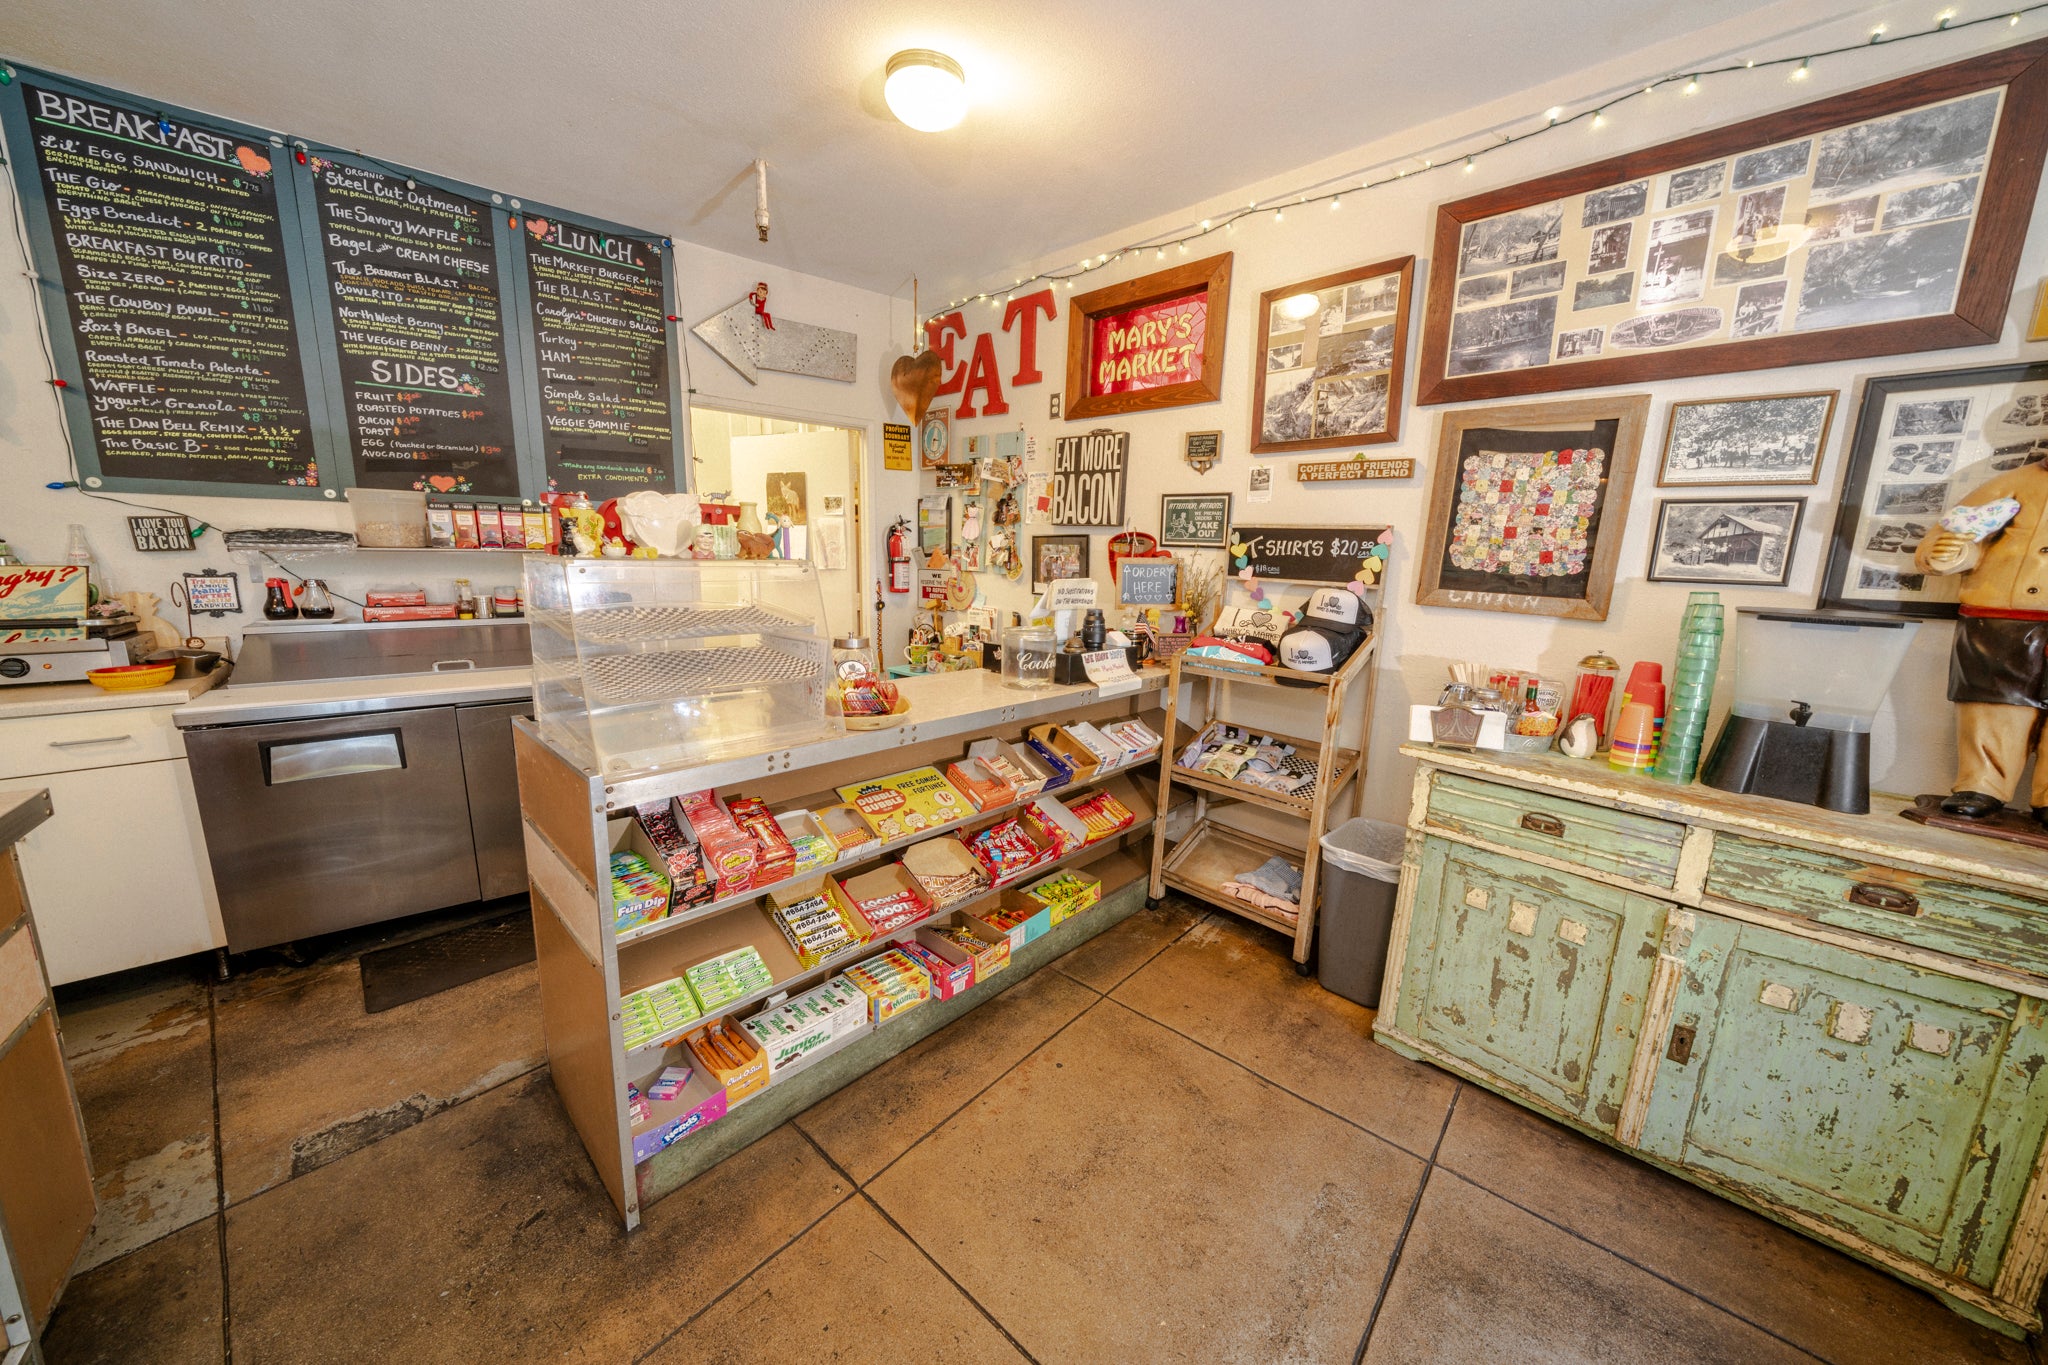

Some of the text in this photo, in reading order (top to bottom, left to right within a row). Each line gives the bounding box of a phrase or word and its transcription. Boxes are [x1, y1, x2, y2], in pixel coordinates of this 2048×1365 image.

[37, 90, 233, 160] BREAKFAST
[88, 145, 127, 163] EGG
[133, 155, 218, 184] SANDWICH
[345, 166, 385, 180] ORGANIC
[44, 167, 81, 184] THE
[325, 171, 471, 217] Steel Cut Oatmeal
[57, 197, 100, 220] Eggs
[103, 205, 182, 229] Benedict
[324, 202, 458, 243] THE Savory WAFFLE
[65, 232, 168, 259] BREAKFAST
[172, 247, 244, 269] BURRITO
[557, 223, 632, 264] LUNCH
[328, 233, 374, 256] Bagel
[396, 246, 440, 264] CREAM
[443, 255, 490, 274] CHEESE
[77, 263, 118, 280] Size
[121, 271, 165, 286] ZERO
[332, 260, 362, 276] The
[364, 263, 412, 281] BREAKFAST
[529, 253, 551, 265] THE
[553, 255, 596, 274] MARKET
[599, 267, 640, 284] BURGER
[334, 281, 403, 303] BOWLRITO
[536, 280, 557, 294] THE
[73, 291, 219, 317] THE COWBOY BOWL
[79, 318, 112, 333] Lox
[125, 322, 177, 339] BAGEL
[407, 316, 444, 336] Benny
[586, 312, 627, 328] CHICKEN
[629, 320, 659, 334] SALAD
[340, 330, 364, 342] THE
[366, 332, 407, 348] VEGGIE
[410, 340, 449, 354] BENNY
[538, 331, 577, 351] Turkey
[1108, 311, 1193, 356] MARY'S
[85, 349, 150, 366] Roasted
[152, 355, 205, 370] Tomato
[209, 361, 263, 376] Polenta
[541, 350, 571, 363] HAM
[925, 288, 1058, 420] EAT
[1099, 343, 1197, 385] MARKET
[370, 359, 459, 389] SIDES
[541, 367, 576, 381] Tuna
[88, 377, 156, 394] WAFFLE
[543, 385, 586, 402] Simple
[93, 394, 236, 412] Yogurt Granola
[355, 391, 395, 402] FRUIT
[356, 403, 461, 419] ROASTED POTATOES
[94, 416, 246, 433] THE DAN BELL REMIX
[358, 416, 395, 426] BACON
[546, 414, 631, 431] VEGGIE SAMMIE
[358, 426, 392, 436] TOAST
[101, 437, 129, 448] The
[184, 439, 201, 453] B
[361, 438, 385, 447] EGG
[361, 449, 411, 459] AVOCADO
[1055, 432, 1122, 473] EAT MORE
[1299, 468, 1409, 480] A PERFECT BLEND
[1300, 460, 1410, 473] COFFEE AND FRIENDS
[605, 474, 649, 483] CONDIMENTS
[1052, 471, 1120, 525] BACON
[134, 528, 187, 537] MORE THAN
[140, 518, 162, 529] LOVE
[163, 518, 184, 529] YOU
[1196, 521, 1219, 530] TAKE
[1197, 529, 1217, 538] OUT
[136, 536, 190, 550] BACON
[1247, 535, 1324, 559] T-SHIRTS
[1132, 566, 1168, 578] ORDER
[1133, 581, 1162, 595] HERE
[1252, 630, 1281, 641] MARKE
[896, 780, 914, 790] FREE
[915, 774, 940, 785] COMICS
[912, 781, 947, 794] FORTUNES
[857, 790, 899, 806] DUBBLE
[861, 796, 905, 813] BUBBLE
[668, 848, 689, 865] POP
[617, 896, 666, 918] Fun Dip
[785, 899, 824, 917] ABBA-ZABA
[795, 911, 837, 930] ABBA-ZABA
[802, 926, 843, 945] ABBA-ZABA
[774, 1030, 825, 1061] Junior
[802, 1034, 831, 1052] Mints
